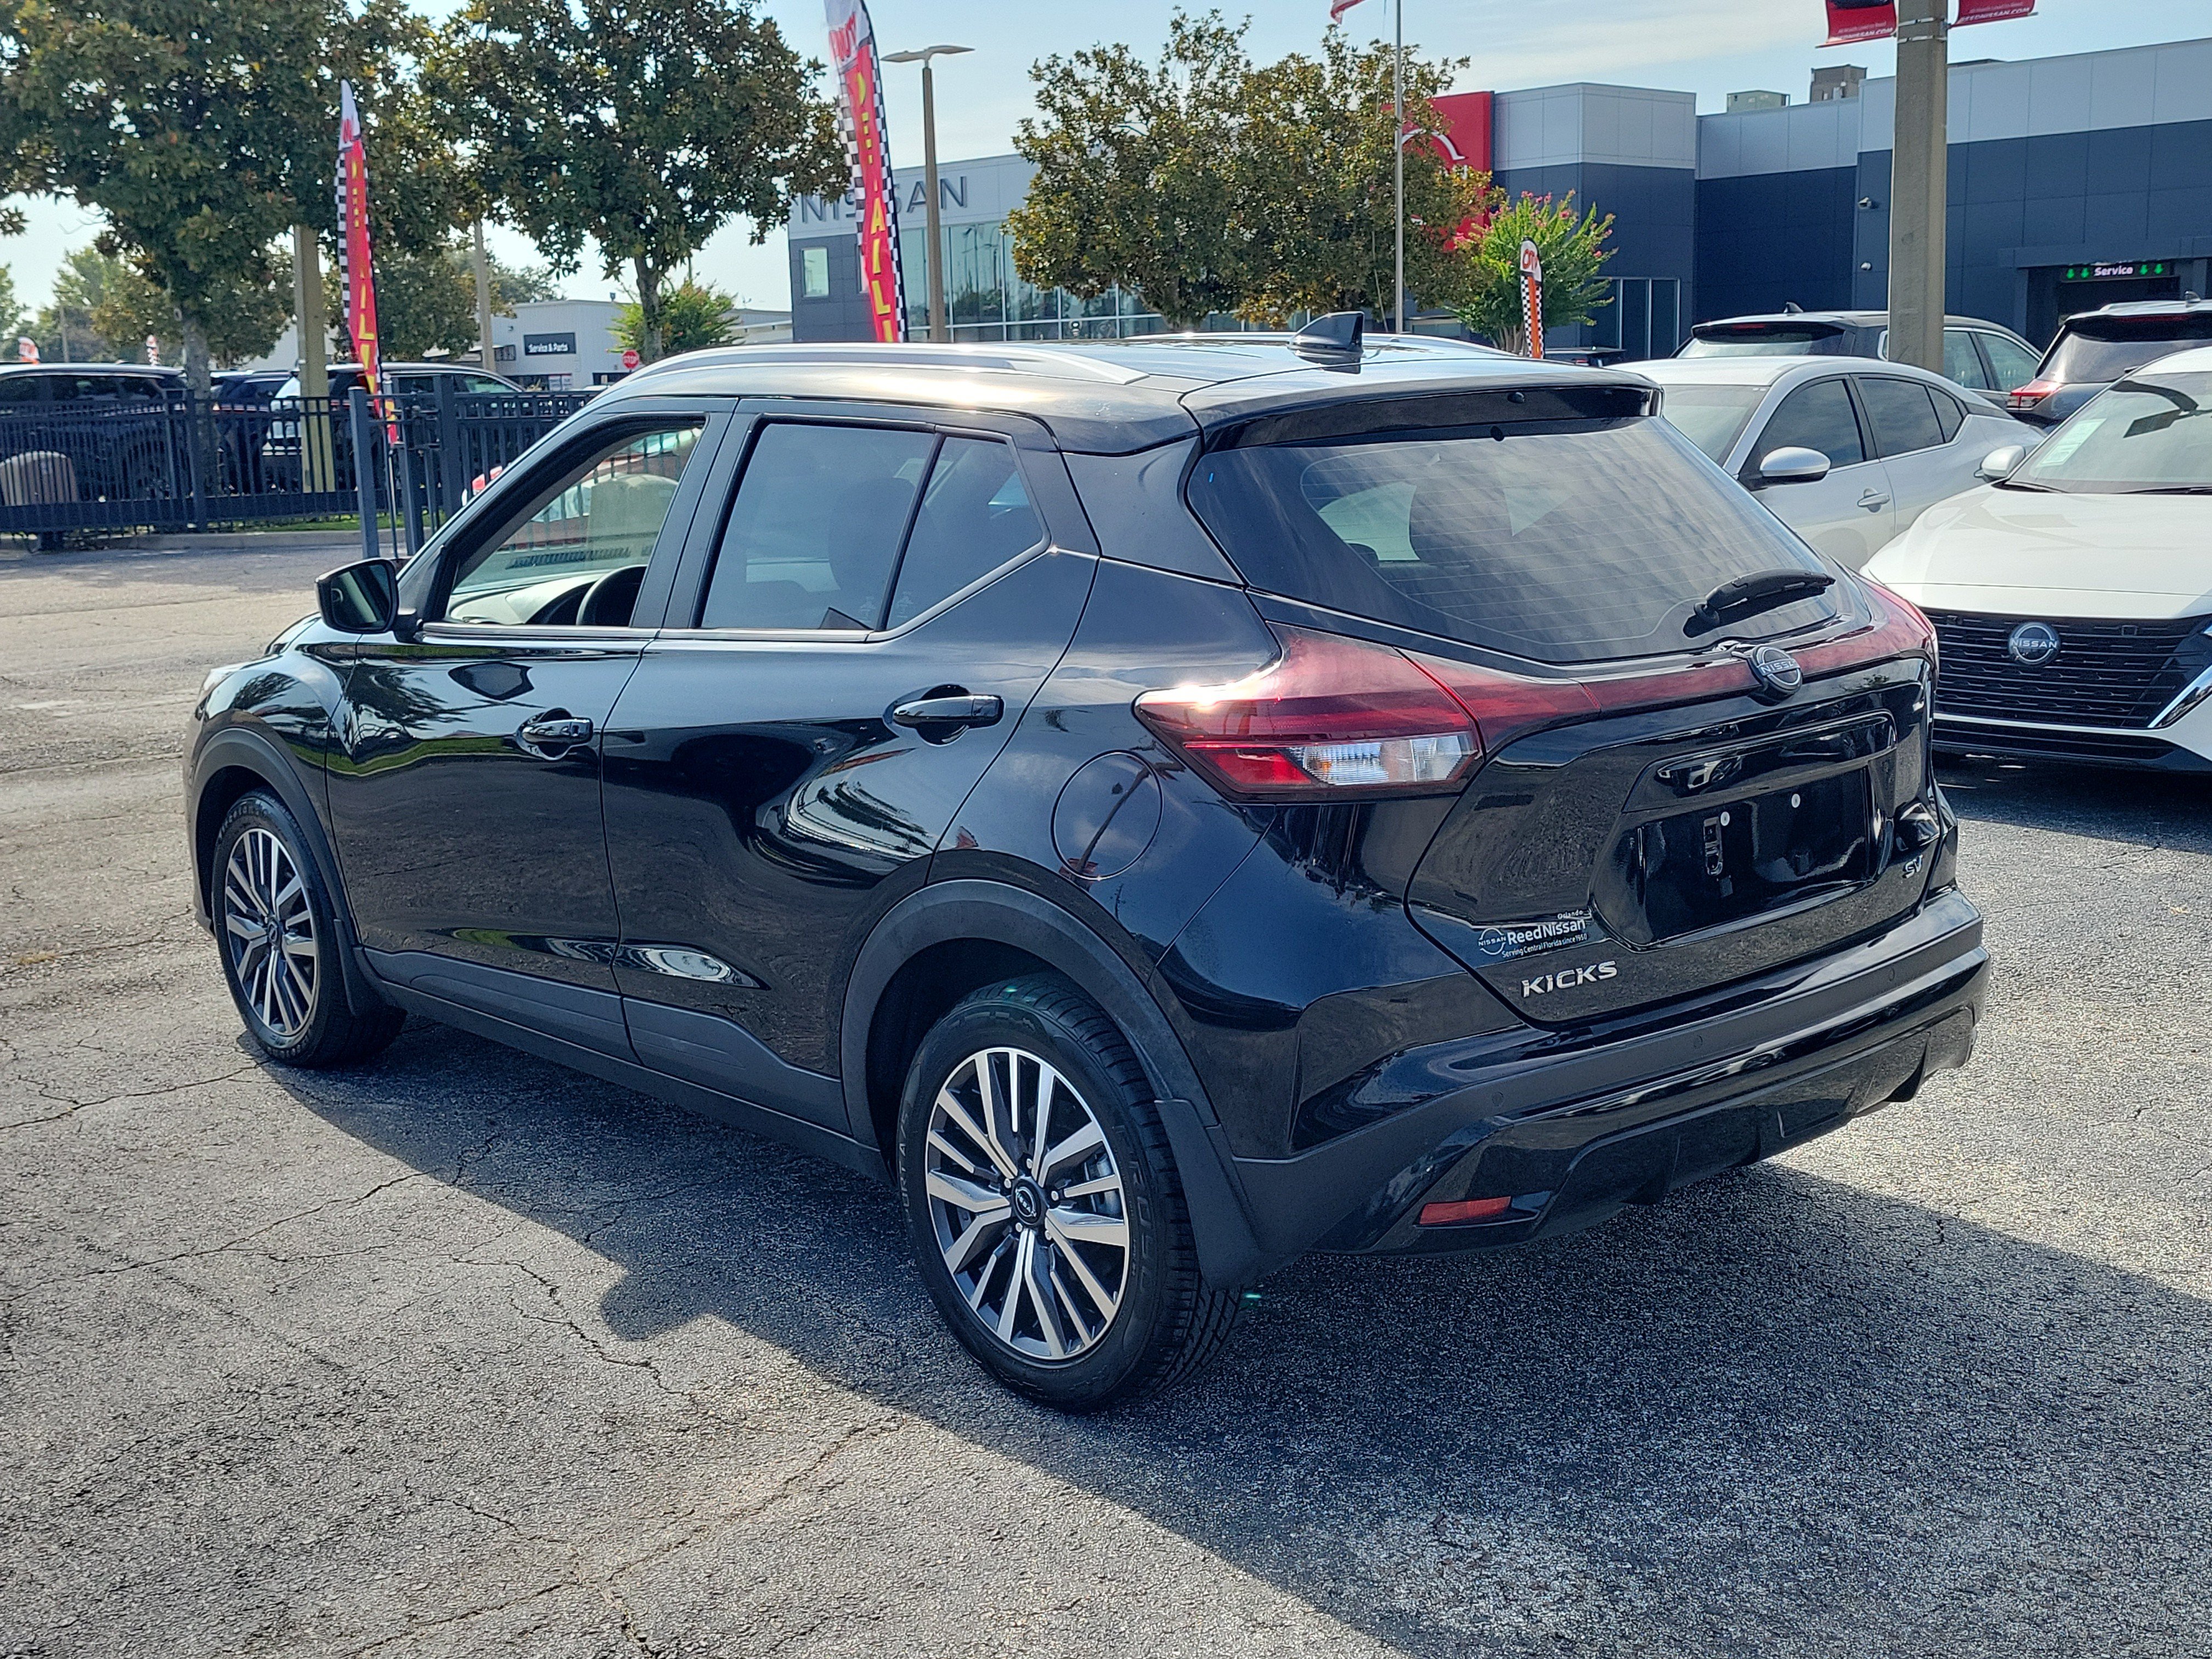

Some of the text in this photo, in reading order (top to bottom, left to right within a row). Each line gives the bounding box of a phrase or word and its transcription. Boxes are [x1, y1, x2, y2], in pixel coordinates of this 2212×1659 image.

[801, 173, 968, 223] NIAN
[2094, 266, 2134, 276] Service
[2011, 638, 2057, 648] NISSAN
[1760, 660, 1796, 674] NISSA
[1905, 854, 1923, 878] SV
[1558, 910, 1583, 919] Orlando
[1478, 936, 1506, 946] NISSAN
[1502, 947, 1523, 958] Serving
[1523, 943, 1543, 953] Central
[1543, 939, 1562, 949] Florida
[1521, 961, 1617, 998] KICKS
